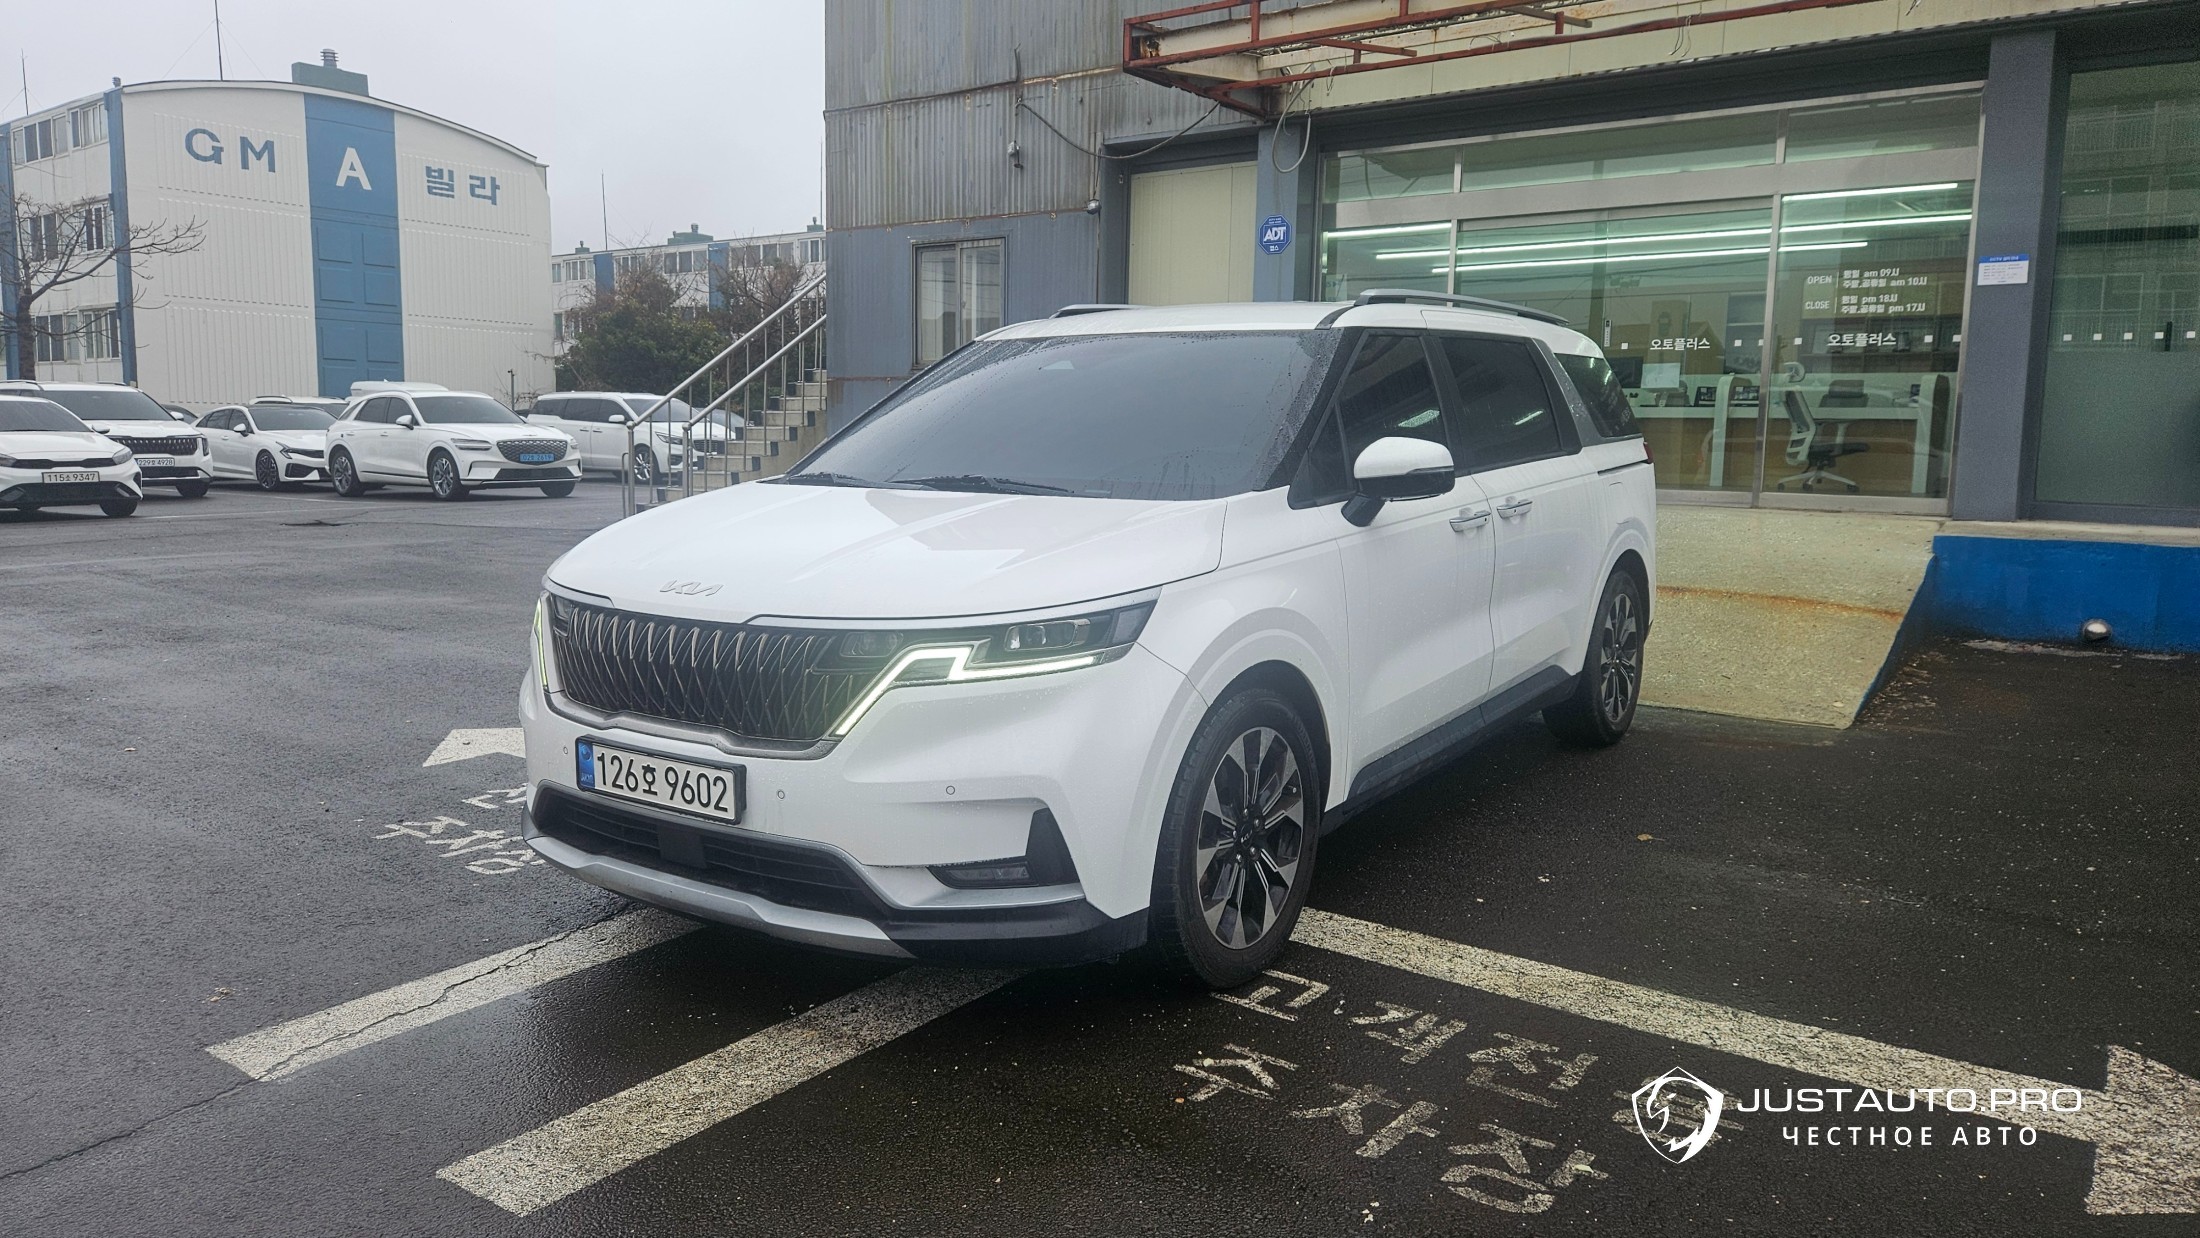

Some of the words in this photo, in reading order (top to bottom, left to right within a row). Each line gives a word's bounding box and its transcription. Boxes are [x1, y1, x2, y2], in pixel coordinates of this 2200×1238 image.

[185, 128, 276, 173] GM
[335, 146, 372, 191] A
[425, 165, 501, 206] 빌라
[1263, 227, 1286, 241] ADT
[1807, 275, 1832, 285] OPEN
[1805, 301, 1830, 310] CLOSE
[1862, 296, 1877, 304] pm
[1888, 305, 1904, 314] pm
[1650, 337, 1710, 350] 오토플러스
[1827, 333, 1896, 347] 오토플러스
[72, 473, 96, 482] 9347
[597, 752, 658, 796] 126호
[664, 766, 728, 813] 9602
